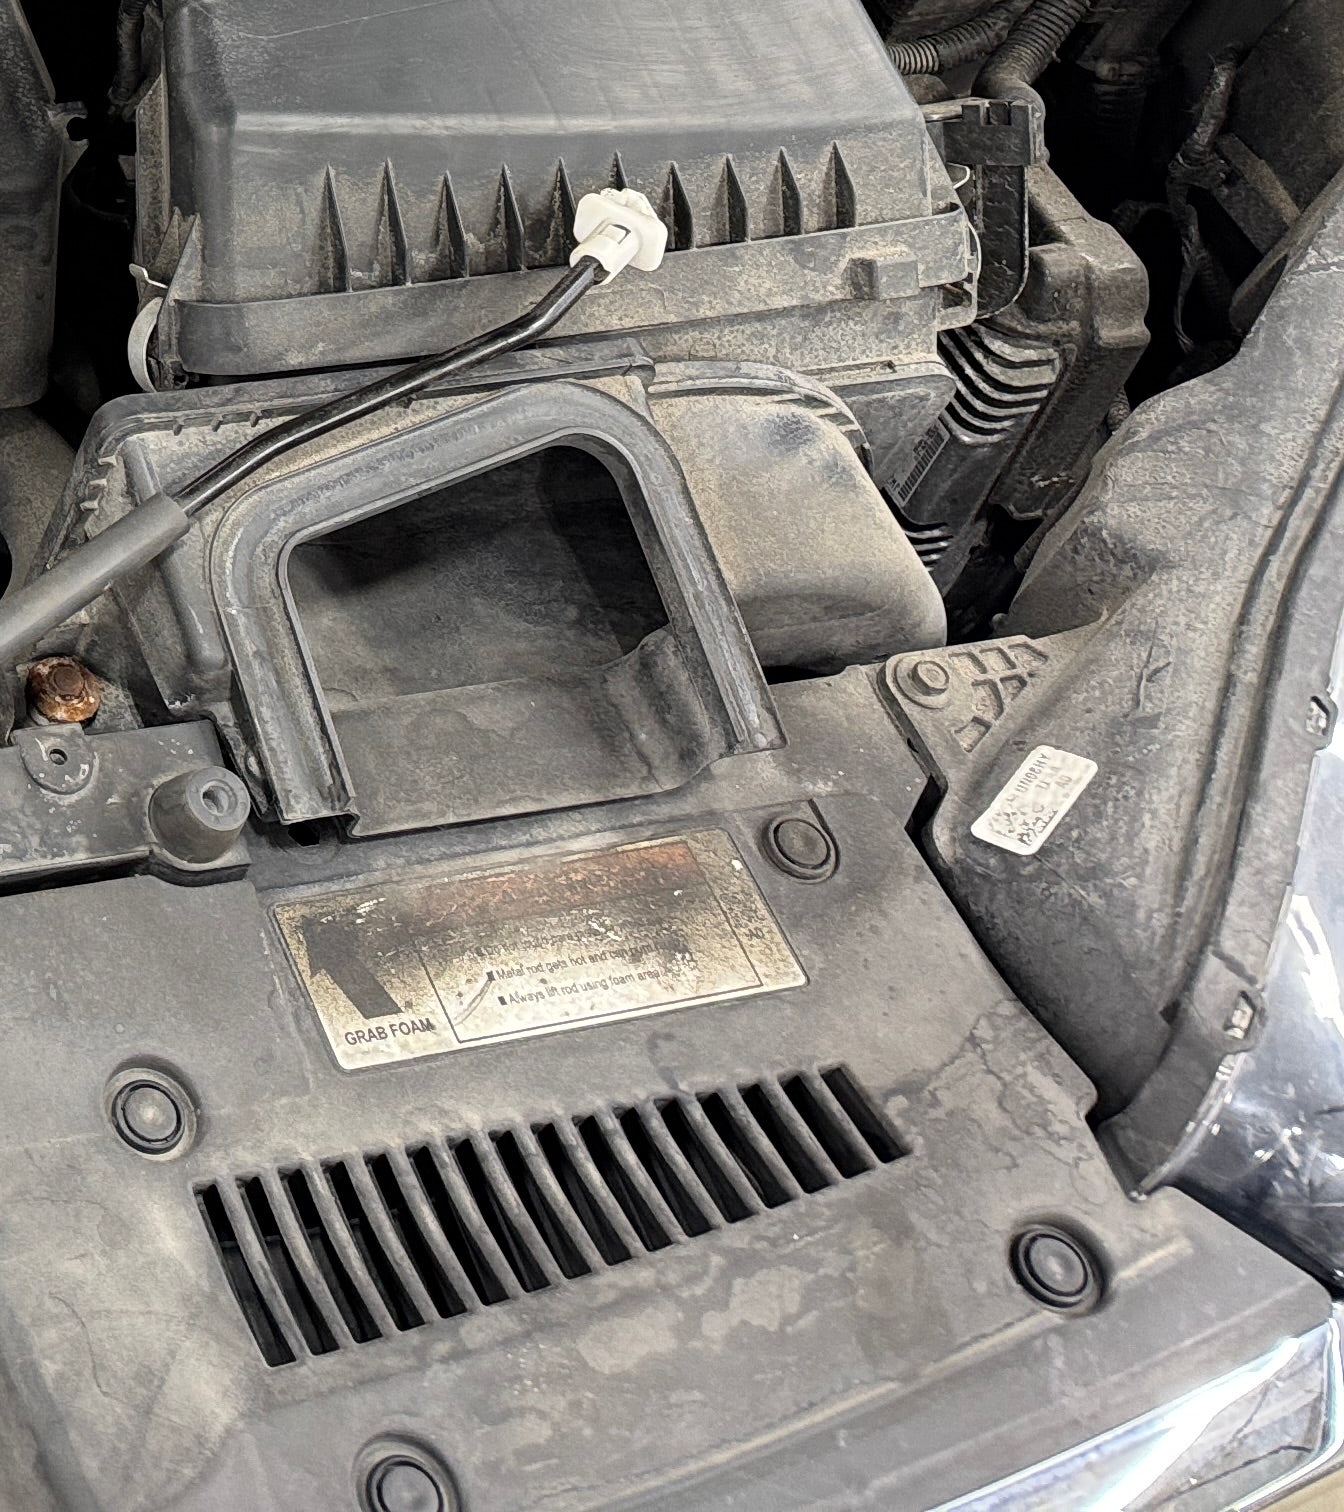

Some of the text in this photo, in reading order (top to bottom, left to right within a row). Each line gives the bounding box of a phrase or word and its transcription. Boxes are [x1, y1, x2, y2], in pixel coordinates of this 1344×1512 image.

[496, 963, 525, 980] Metal
[526, 962, 545, 975] rod
[545, 959, 569, 974] gets
[568, 954, 588, 967] hot
[588, 950, 608, 964] and
[509, 990, 546, 1004] Always
[544, 985, 560, 998] lift
[560, 982, 580, 996] rod
[579, 978, 610, 991] using
[609, 974, 636, 986] foam
[344, 1018, 435, 1045] GRAB FOAM
